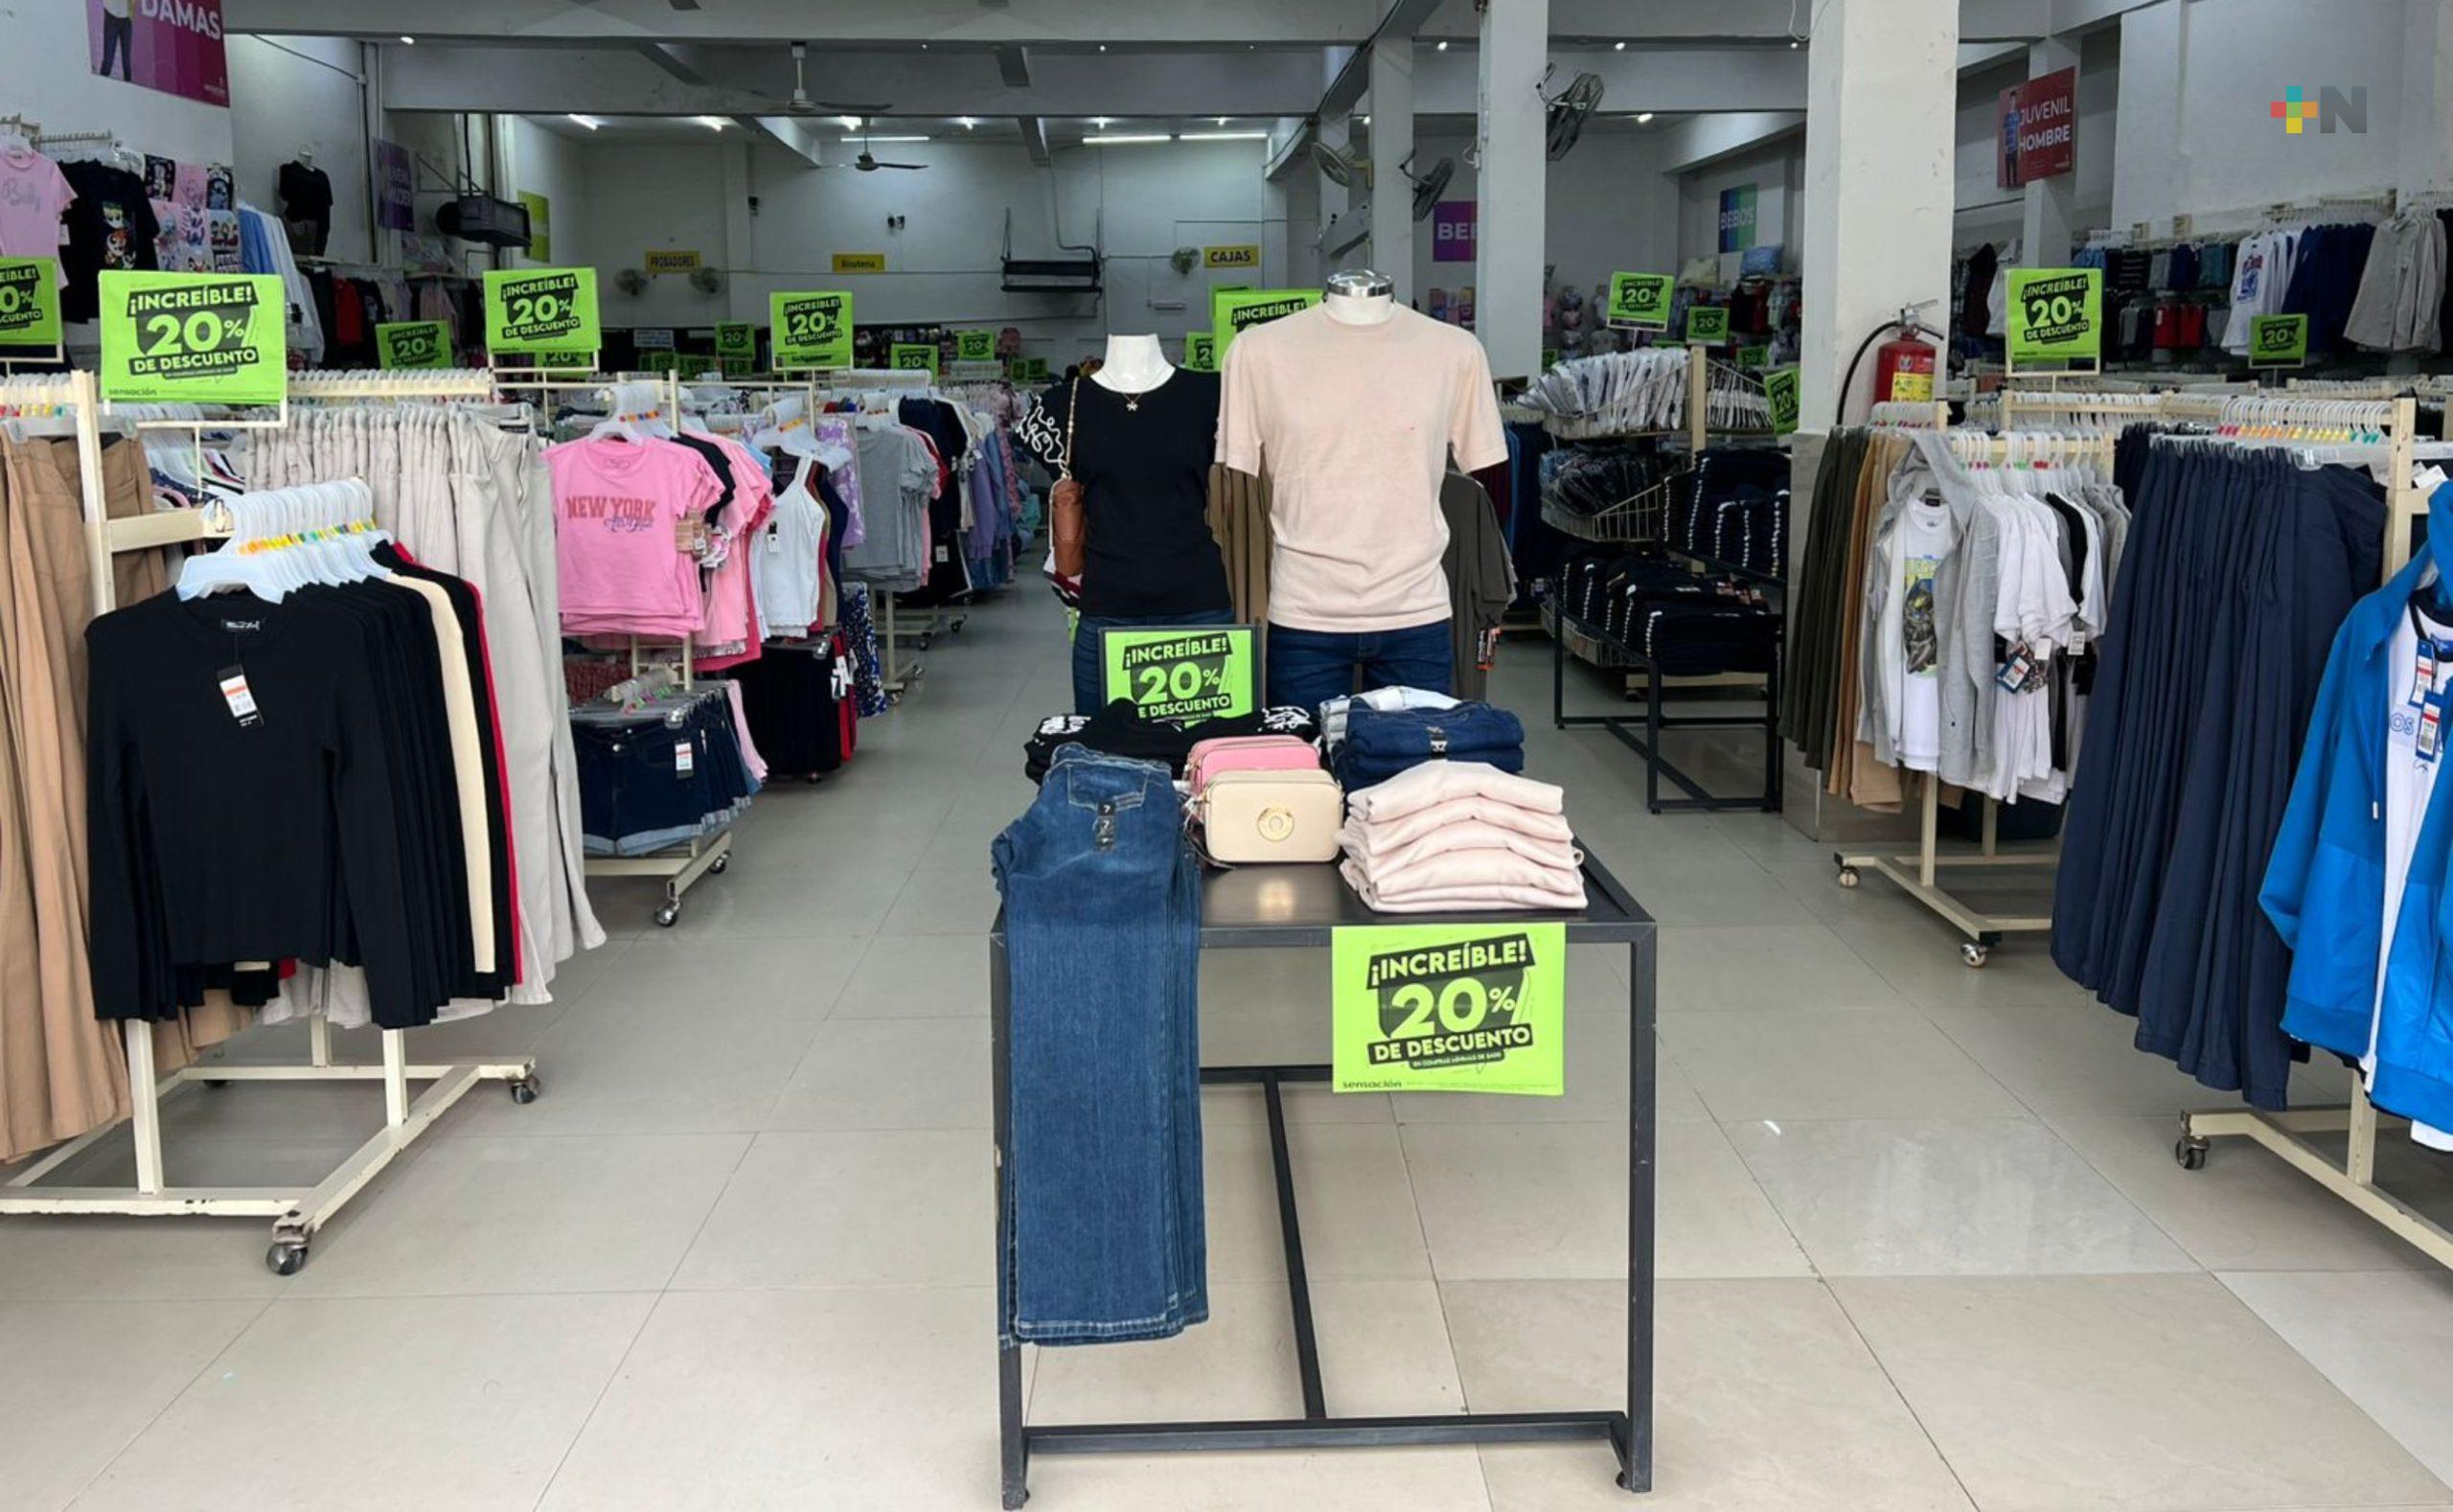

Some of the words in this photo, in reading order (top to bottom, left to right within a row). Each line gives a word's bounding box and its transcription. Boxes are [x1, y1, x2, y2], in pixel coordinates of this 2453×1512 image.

[2021, 97, 2072, 126] JUVENIL
[2019, 125, 2072, 151] HOMBRE
[1210, 250, 1251, 263] CAJAS
[129, 286, 253, 314] ¡INCREÍBLE!
[513, 294, 571, 326] 20%
[2031, 295, 2084, 327] 20%
[146, 310, 246, 356] 20%
[505, 328, 518, 337] DE
[520, 318, 579, 334] DESCUENTO
[791, 311, 836, 335] 20%
[2027, 331, 2038, 340] DE
[2040, 321, 2088, 338] DESCUENTO
[134, 359, 157, 373] DE
[160, 349, 258, 371] DESCUENTO
[565, 495, 607, 519] NEW
[609, 496, 657, 520] YORK
[1125, 637, 1227, 668] ¡INCREÍBLE!
[1138, 661, 1220, 704] 20%
[1150, 696, 1230, 717] DESCUENTO
[1370, 939, 1526, 987] ¡INCREÍBLE!
[1390, 976, 1516, 1039] 20%
[1374, 1042, 1402, 1062] DE
[1407, 1026, 1531, 1058] DESCUENTO
[1342, 1078, 1403, 1089] sensación
